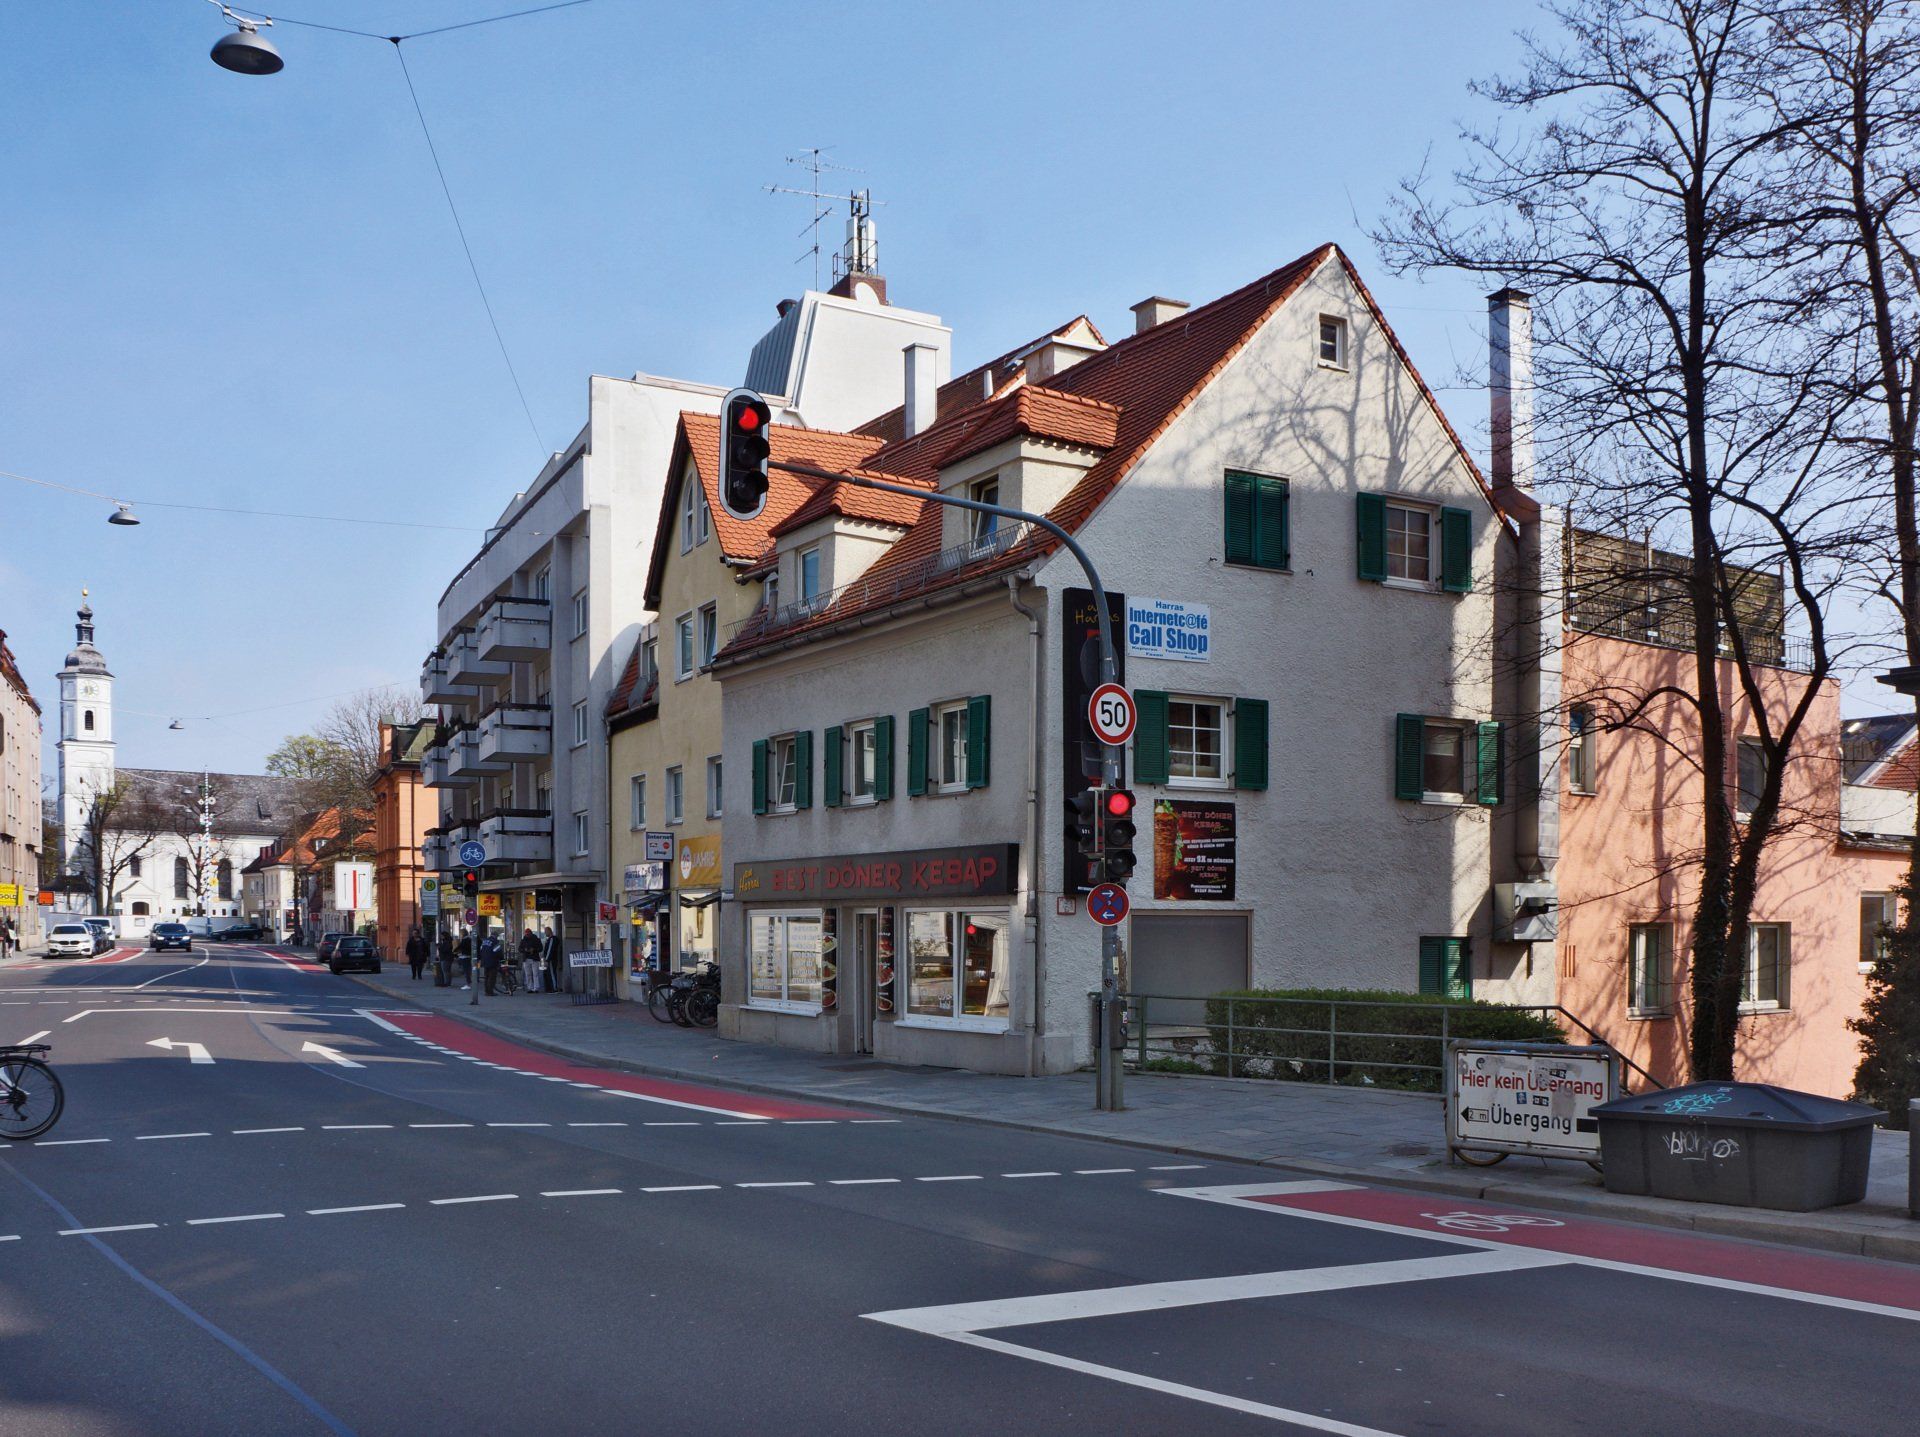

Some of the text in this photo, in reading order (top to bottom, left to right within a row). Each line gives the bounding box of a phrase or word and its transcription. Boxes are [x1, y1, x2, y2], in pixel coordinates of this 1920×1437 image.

[1075, 609, 1120, 624] Hars
[1155, 601, 1184, 611] Harras
[1129, 607, 1208, 629] Internetc@fé
[1129, 623, 1208, 653] Call Shop
[1101, 701, 1126, 727] 50
[1181, 811, 1202, 819] BEST
[770, 856, 998, 892] BEST DÖNER KEBAP
[1462, 1070, 1491, 1087] Hier
[1495, 1072, 1524, 1090] kein
[1491, 1103, 1571, 1134] Übergang
